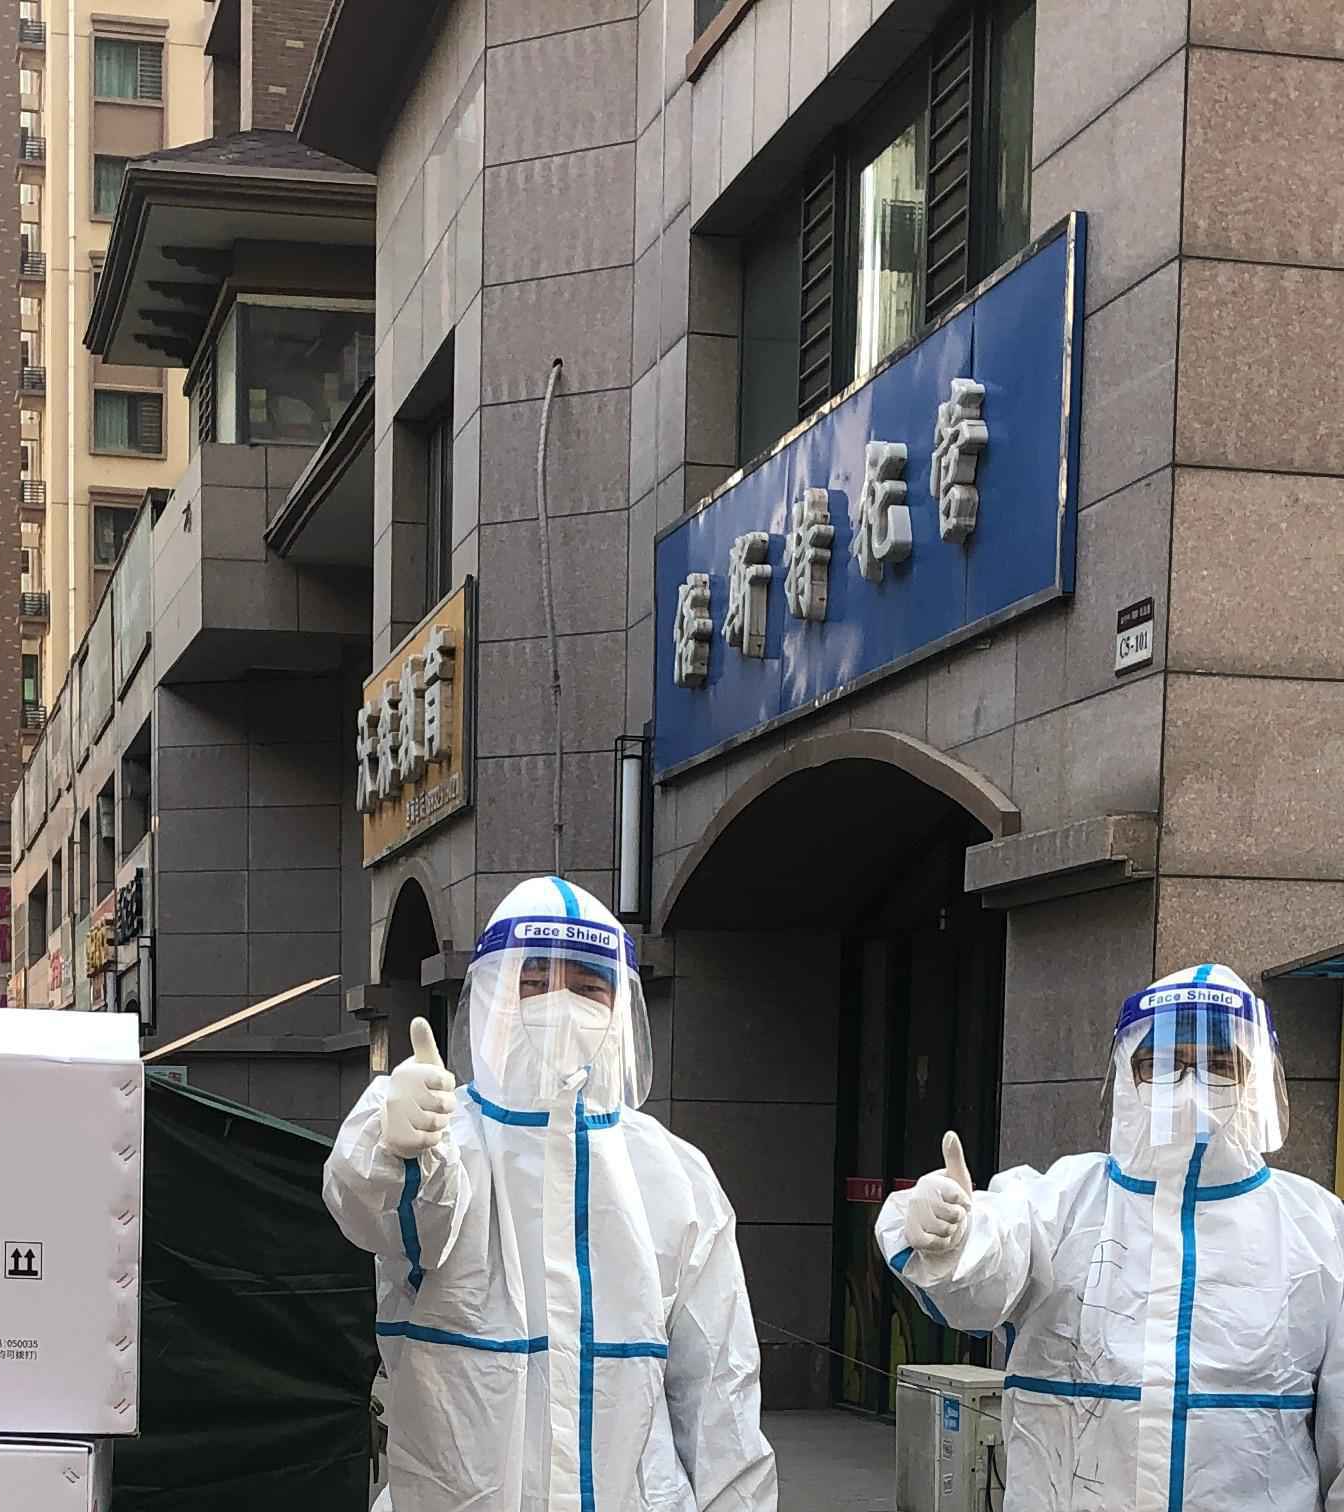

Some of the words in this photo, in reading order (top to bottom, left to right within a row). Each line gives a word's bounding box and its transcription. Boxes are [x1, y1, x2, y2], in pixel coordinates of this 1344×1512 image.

[524, 924, 560, 937] Face
[565, 926, 611, 946] Shield
[1148, 992, 1181, 1006] Face
[1186, 990, 1233, 1005] Shield
